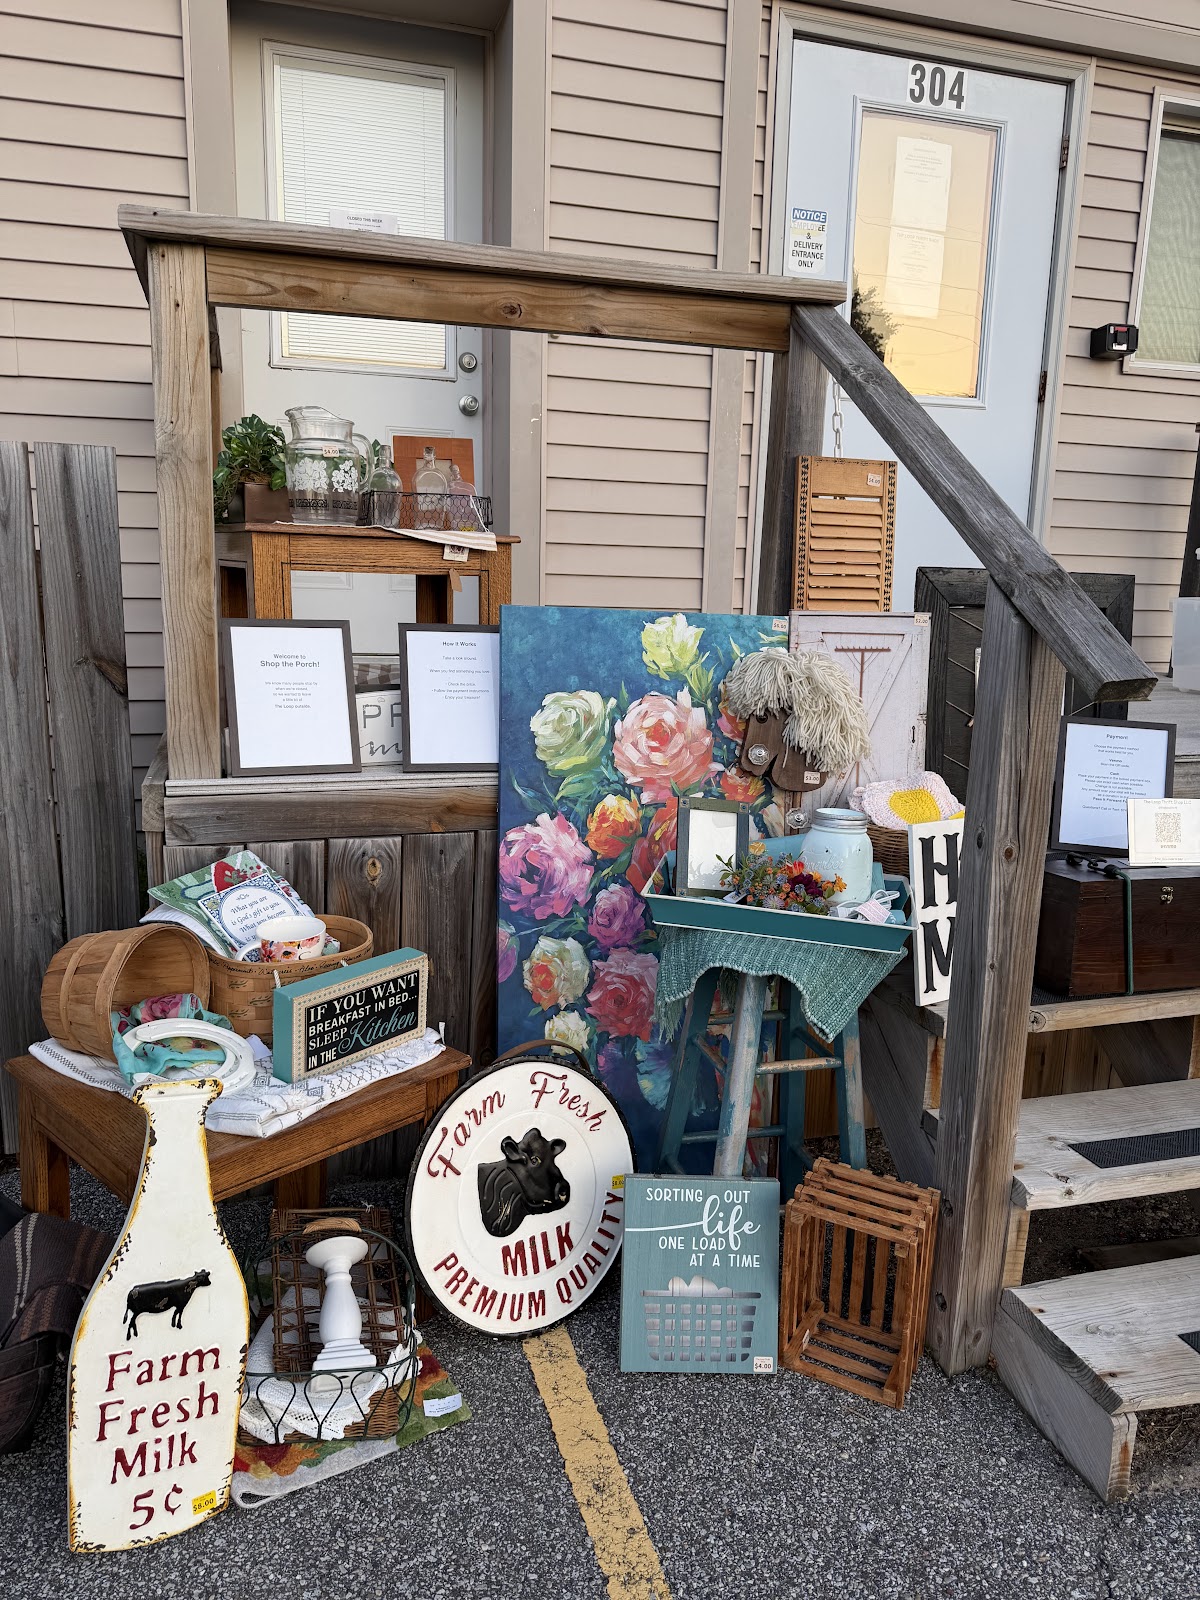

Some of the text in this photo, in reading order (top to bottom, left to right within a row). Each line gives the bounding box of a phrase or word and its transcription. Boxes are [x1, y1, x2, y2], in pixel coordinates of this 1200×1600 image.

[910, 64, 965, 110] 304
[794, 210, 826, 222] NOTICE
[794, 240, 823, 250] DELIVERY
[806, 232, 811, 240] &
[792, 250, 824, 260] ENTRANCE
[798, 260, 814, 268] ONLY
[260, 660, 280, 668] Shop
[231, 904, 248, 914] What
[248, 900, 258, 909] you
[237, 913, 253, 924] God's
[253, 909, 262, 918] gift
[269, 902, 282, 911] you.
[240, 922, 256, 932] What
[267, 909, 286, 920] become
[309, 972, 418, 1024] IF YOU WANT
[309, 1005, 371, 1037] BREAKFAST
[374, 1000, 385, 1012] IN
[308, 1005, 417, 1070] IN THE Kitchen
[309, 1027, 348, 1051] SLEEP
[427, 1071, 607, 1178] Farm Fresh
[646, 1188, 750, 1204] SORTING OUT
[702, 1194, 761, 1251] life
[501, 1221, 574, 1277] MILK
[659, 1236, 726, 1250] ONE LOAD
[433, 1191, 624, 1322] PREMIUM QUALITY
[690, 1254, 760, 1268] AT A TIME
[105, 1347, 220, 1392] Farm
[96, 1380, 220, 1442] Fresh
[110, 1430, 198, 1484] Milk
[193, 1498, 214, 1512] $8.00
